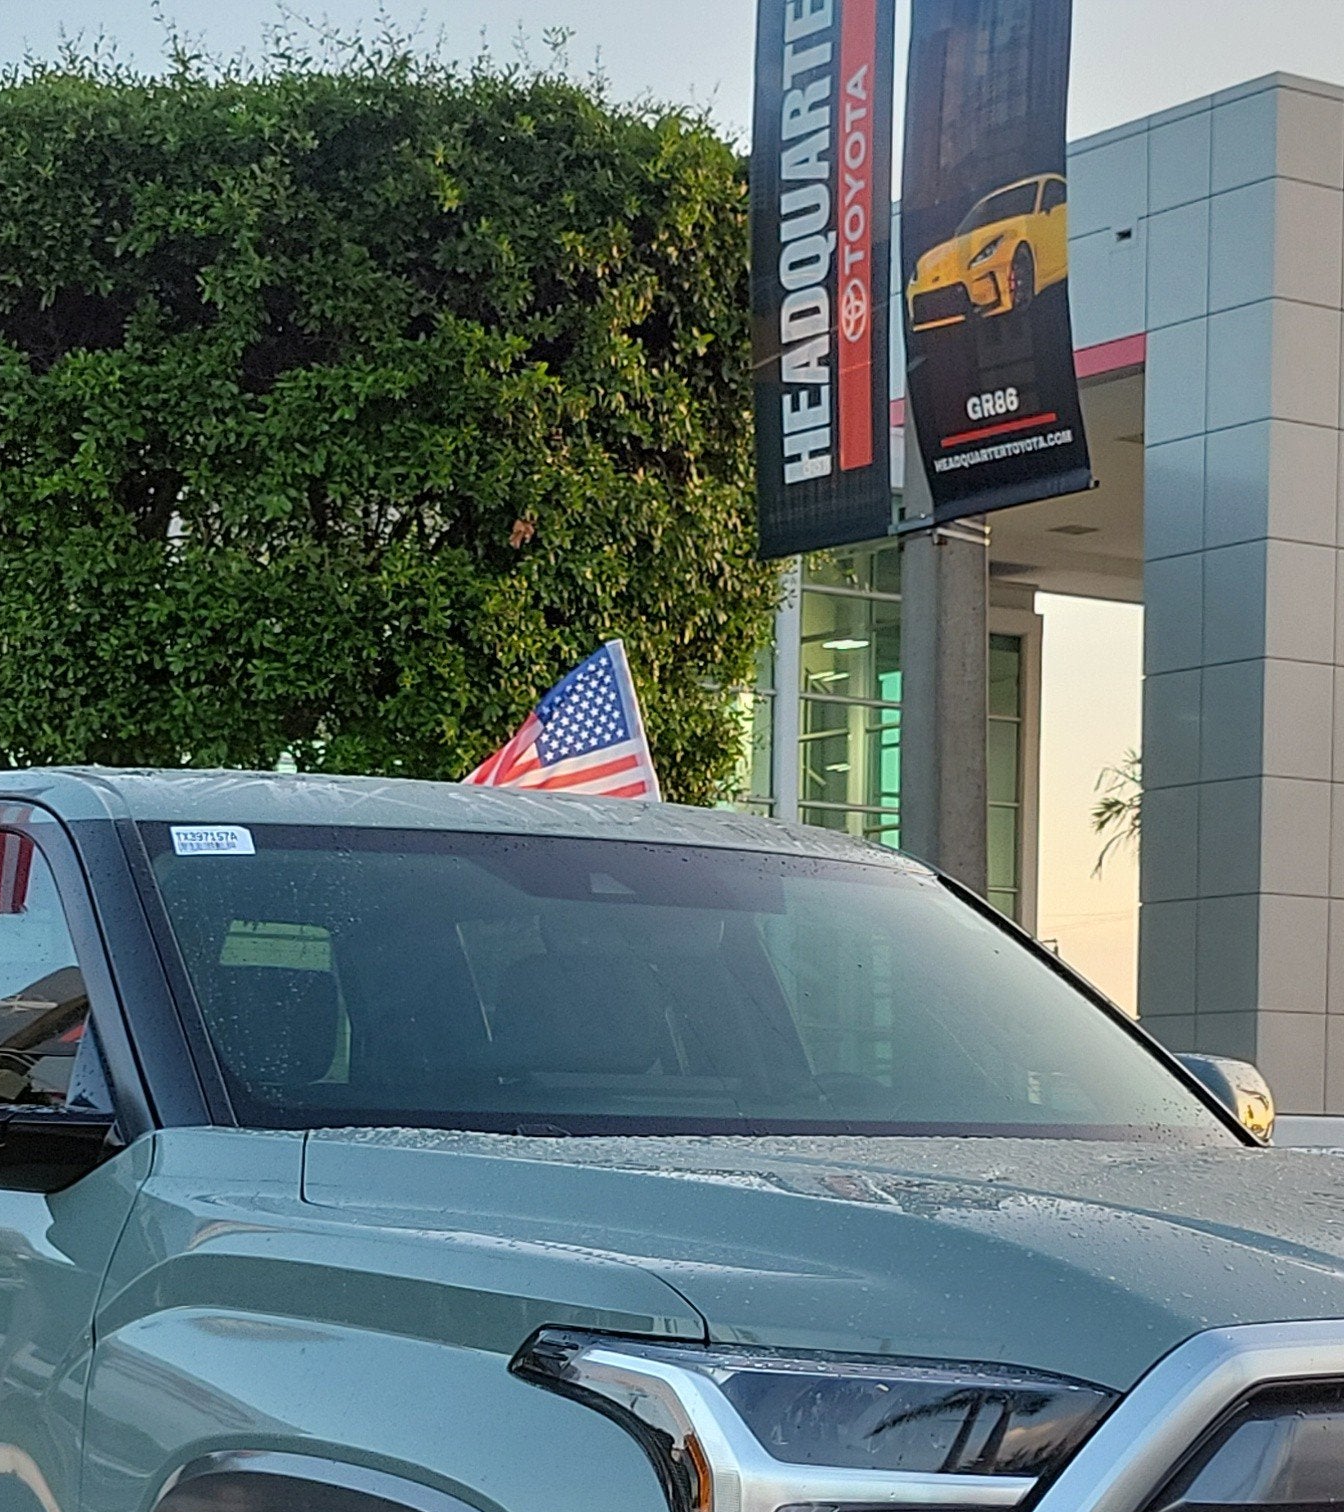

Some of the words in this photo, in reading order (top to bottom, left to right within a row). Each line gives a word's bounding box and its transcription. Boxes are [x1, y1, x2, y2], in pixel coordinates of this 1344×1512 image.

[844, 65, 874, 274] TOYOTA
[780, 0, 837, 485] HEADQUARTE
[934, 429, 1073, 473] HEADQUARTERTOYOTA.COM
[966, 387, 1019, 420] GR86
